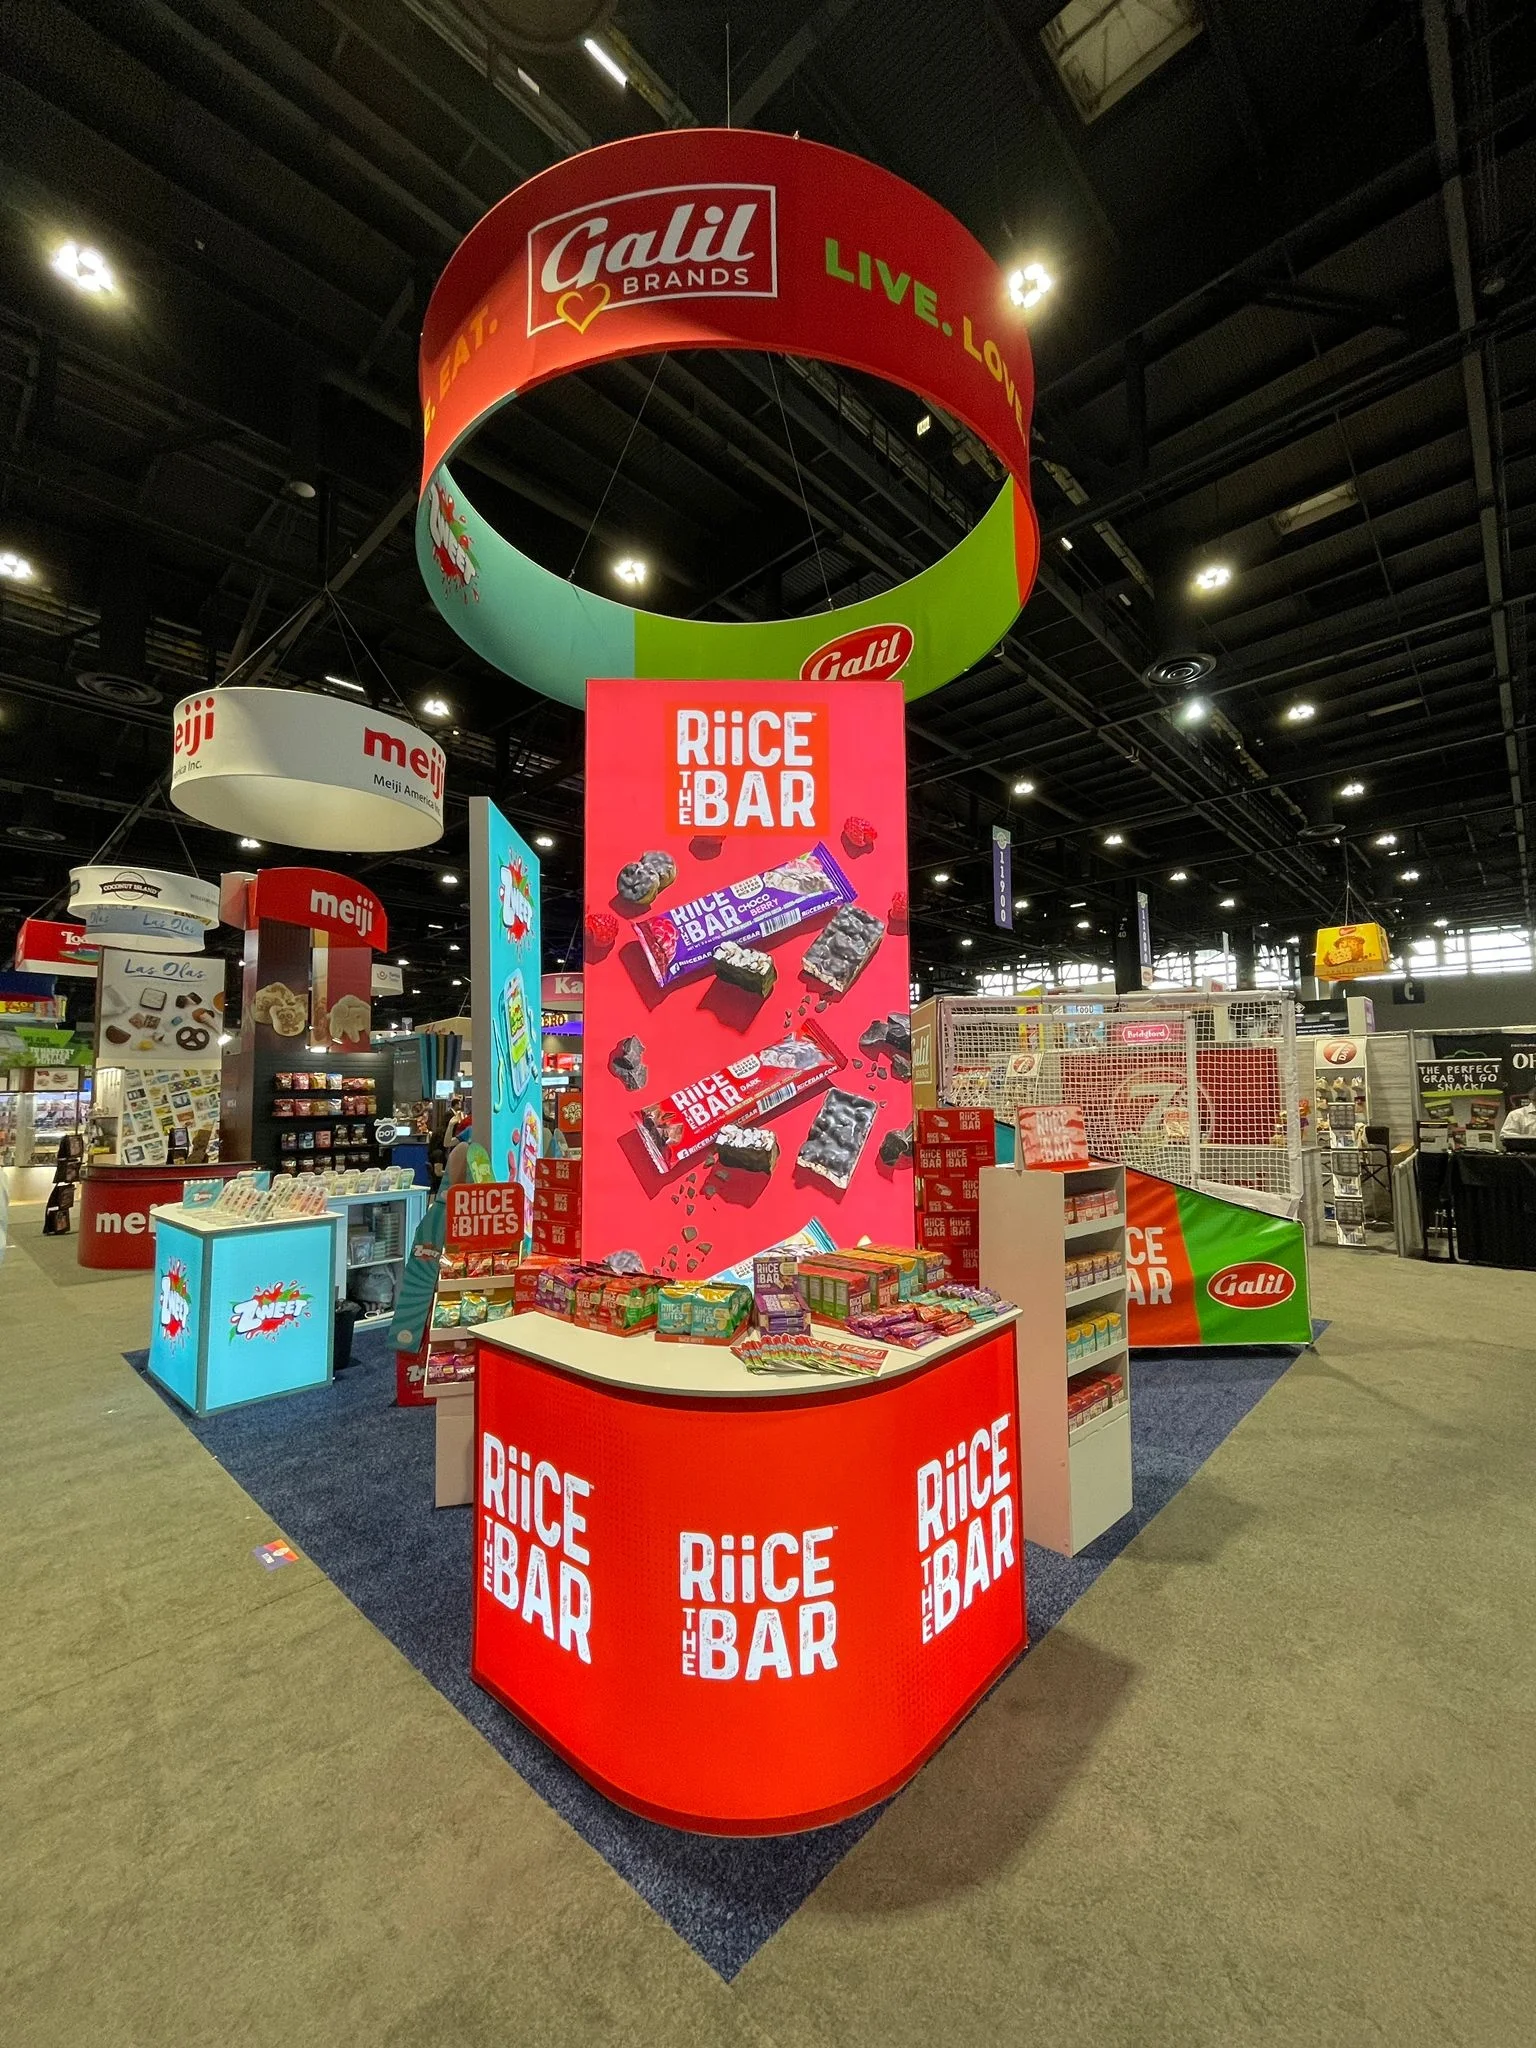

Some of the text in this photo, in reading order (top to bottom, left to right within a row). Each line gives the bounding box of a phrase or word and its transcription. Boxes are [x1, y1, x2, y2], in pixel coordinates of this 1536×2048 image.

[540, 203, 758, 294] Galil
[623, 268, 750, 295] BRANDS
[825, 237, 953, 337] LIVE.
[439, 303, 498, 403] EAT.
[811, 632, 901, 681] Galil
[676, 709, 818, 768] RiiCE
[363, 726, 445, 800] meiji
[373, 774, 402, 794] Meiji
[679, 770, 818, 829] THE BAR
[102, 883, 159, 896] COCONUT ISLAND
[310, 889, 374, 937] meiji
[737, 893, 771, 914] CHOCO
[749, 898, 780, 917] BERRY
[678, 926, 692, 947] THE
[684, 904, 743, 944] BAR
[124, 958, 208, 980] Las Olas
[1418, 1064, 1500, 1075] THE PERFECT
[1422, 1075, 1456, 1084] GRAB
[1479, 1074, 1498, 1083] GO
[740, 1078, 762, 1092] DARK
[1437, 1083, 1484, 1092] SNACK!
[687, 1085, 744, 1127] BAR
[379, 1130, 395, 1138] DOT
[962, 1121, 981, 1131] BAR
[922, 1159, 942, 1169] BAR
[948, 1158, 968, 1168] BAR
[454, 1188, 515, 1216] RiiCE
[458, 1213, 519, 1237] BITES
[926, 1227, 946, 1237] BAR
[952, 1226, 972, 1237] BAR
[759, 1273, 780, 1284] BAR
[1214, 1273, 1285, 1297] Galil
[232, 1299, 308, 1335] ZWEET
[916, 1414, 1012, 1553] RiiCE
[483, 1431, 590, 1567] RiiCE
[678, 1526, 836, 1604] RiiCE
[920, 1493, 1015, 1645] THE BAR
[483, 1514, 592, 1665] THE BAR
[682, 1600, 838, 1681] THE BAR
